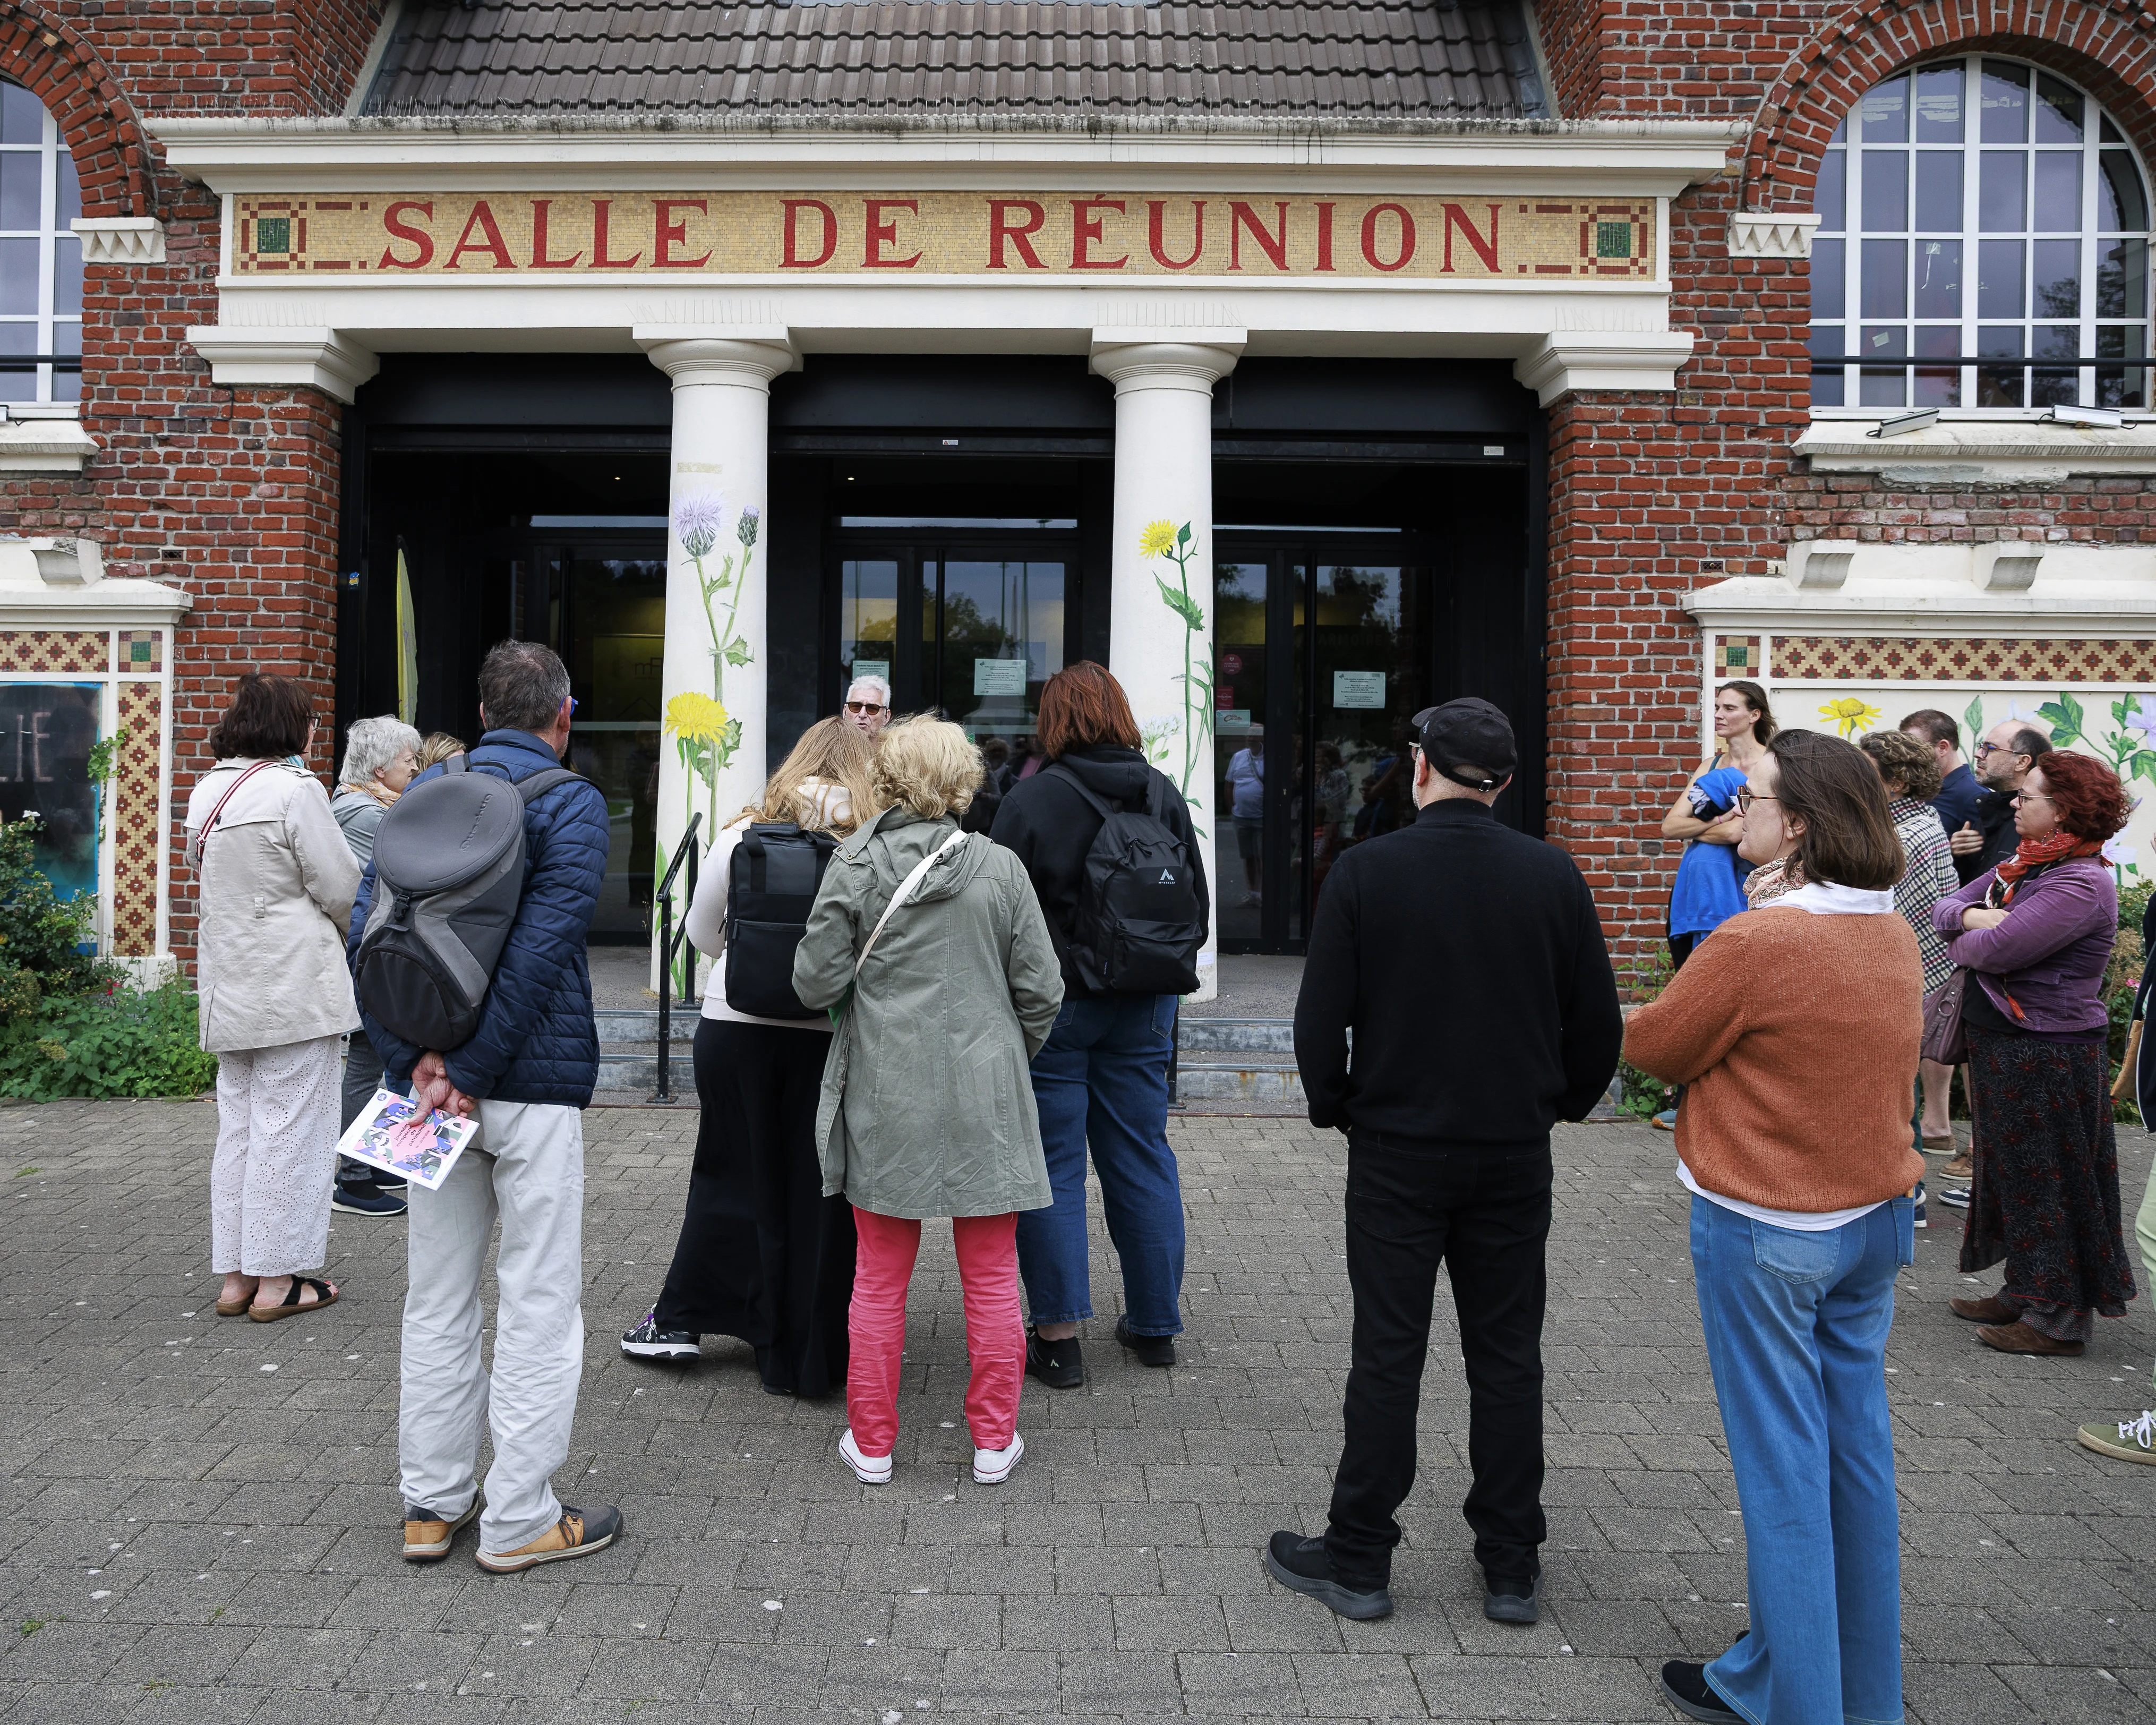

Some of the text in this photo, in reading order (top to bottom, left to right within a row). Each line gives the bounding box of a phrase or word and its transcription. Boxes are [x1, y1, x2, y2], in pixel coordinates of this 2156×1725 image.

[378, 194, 1503, 273] SALLE DE RÉUNION
[460, 793, 493, 852] Quechua
[408, 1124, 426, 1146] patrimoine
